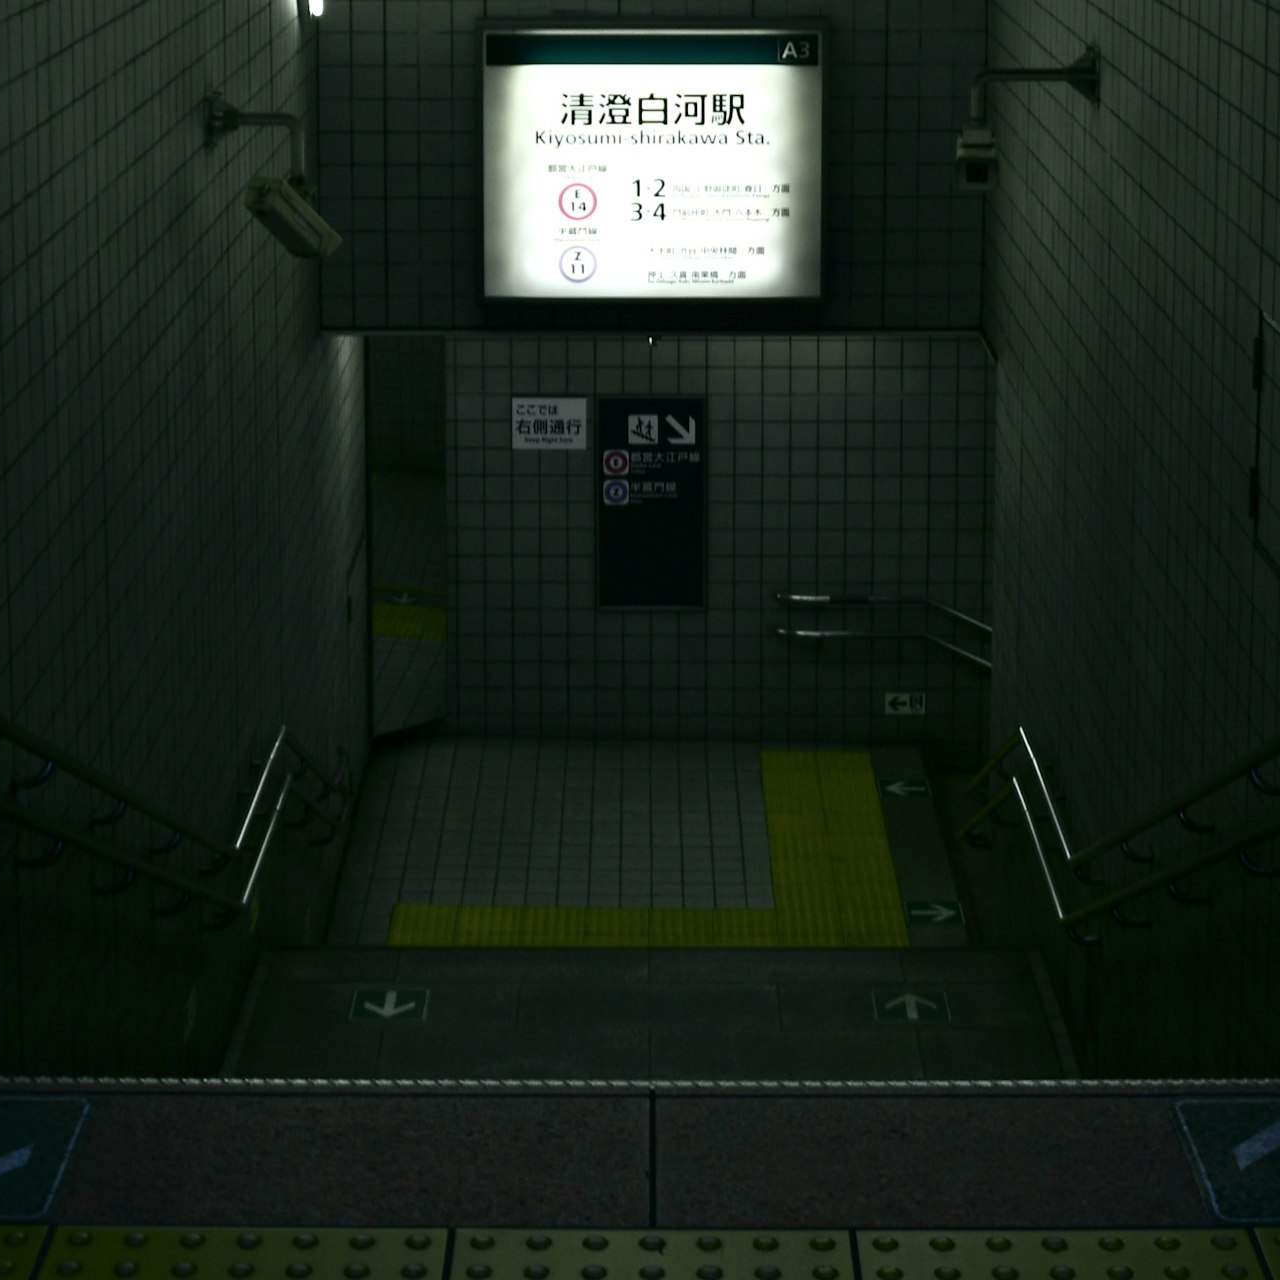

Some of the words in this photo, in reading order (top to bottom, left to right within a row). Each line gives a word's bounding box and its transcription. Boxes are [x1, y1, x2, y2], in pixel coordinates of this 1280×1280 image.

[781, 40, 811, 61] A3
[561, 93, 746, 126] 清澄白河駅
[535, 129, 729, 149] Kiyosumi-shirakawa
[736, 129, 771, 146] Sta.
[574, 188, 581, 199] E
[570, 201, 587, 212] 14
[574, 251, 582, 261] Z
[570, 263, 586, 275] 11
[516, 404, 558, 416] ここでは
[516, 419, 581, 435] 右側通行
